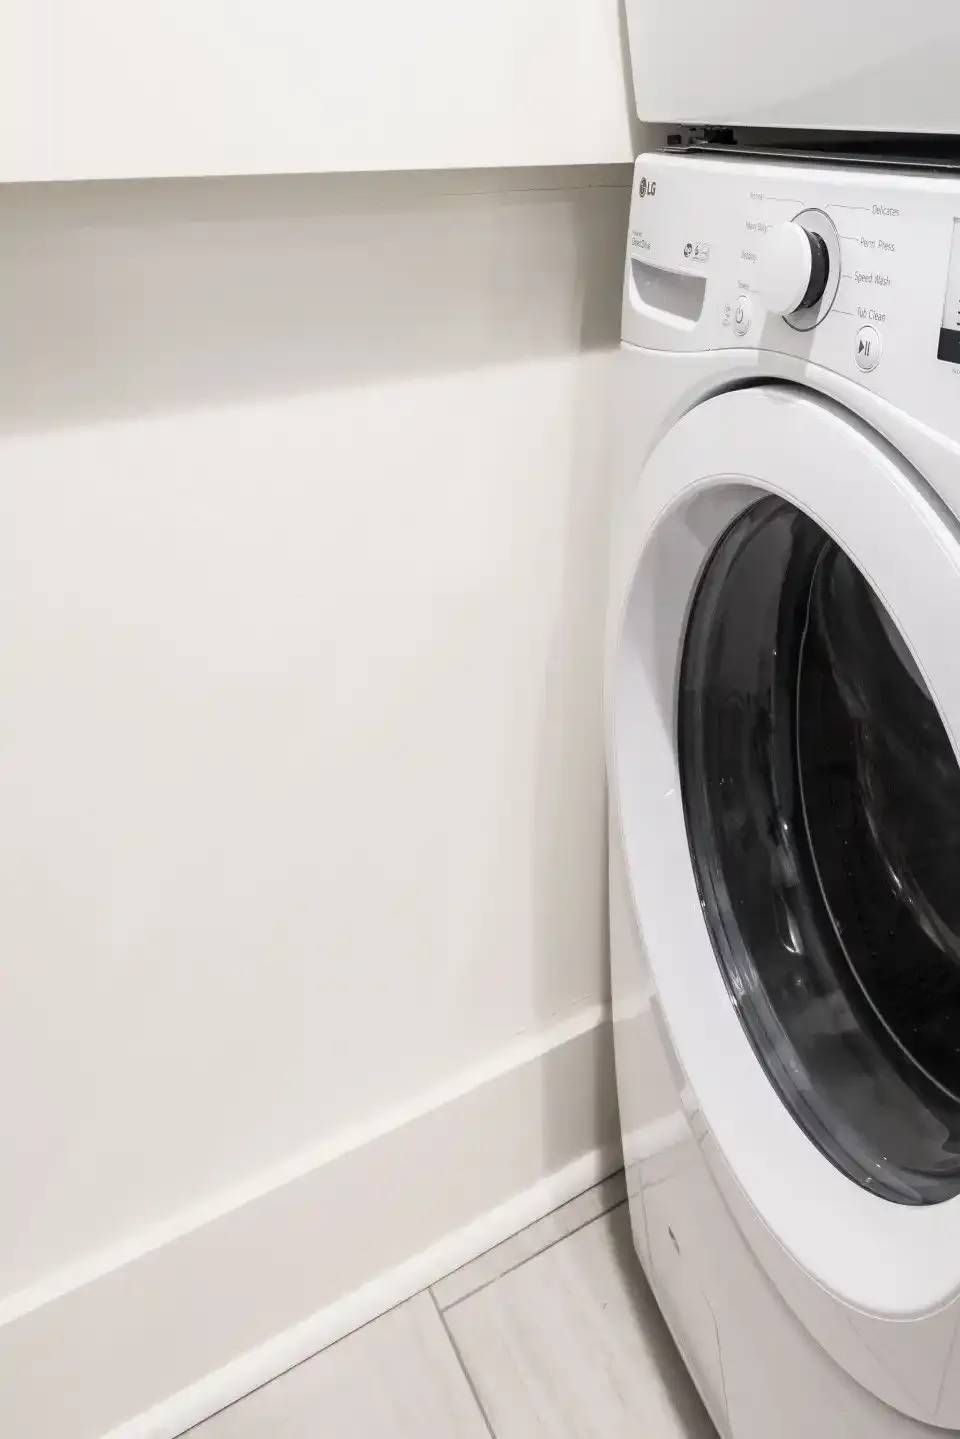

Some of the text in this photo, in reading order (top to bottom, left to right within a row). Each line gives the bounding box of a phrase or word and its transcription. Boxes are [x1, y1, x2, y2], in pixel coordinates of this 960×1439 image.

[872, 204, 900, 217] Delicates
[854, 271, 891, 288] Speed Wash
[856, 306, 886, 321] Tub Clean
